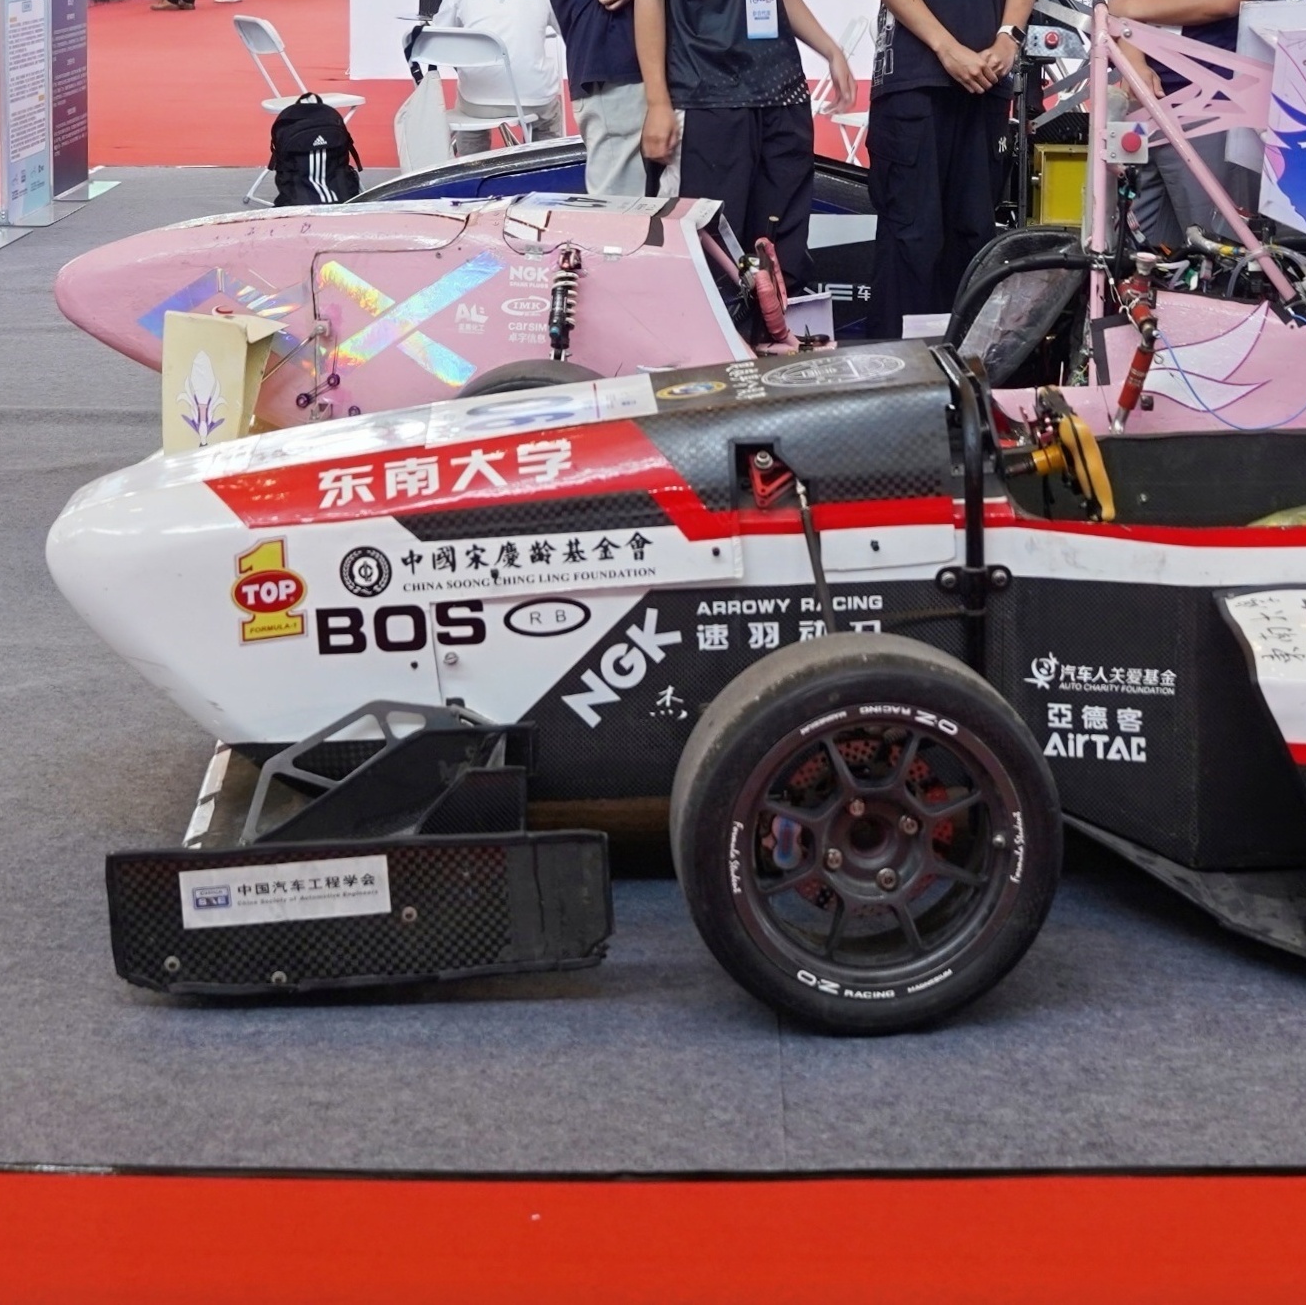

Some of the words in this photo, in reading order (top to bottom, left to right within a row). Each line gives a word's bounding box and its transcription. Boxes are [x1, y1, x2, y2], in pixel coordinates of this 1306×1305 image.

[509, 266, 550, 282] NGK
[319, 438, 573, 509] 东南大学
[401, 531, 654, 575] 中國宋慶齡基金會
[403, 581, 443, 593] CHINA
[444, 578, 491, 590] SOONG
[494, 575, 536, 586] CHING
[538, 572, 570, 584] LING
[573, 566, 657, 582] FOUNDATION
[241, 584, 297, 606] TOP
[697, 600, 791, 617] ARROWY
[315, 599, 487, 655] BOS
[561, 607, 683, 728] NGK
[1060, 665, 1177, 688] 汽车人关爱基金
[1059, 682, 1081, 693] AUTO
[1083, 683, 1119, 694] CHARITY
[1121, 683, 1175, 695] FOUNDATION
[859, 704, 912, 716] RACING
[1047, 702, 1143, 730] 亞德客
[237, 872, 376, 896] 中国汽车工程学会
[843, 988, 896, 999] RACING
